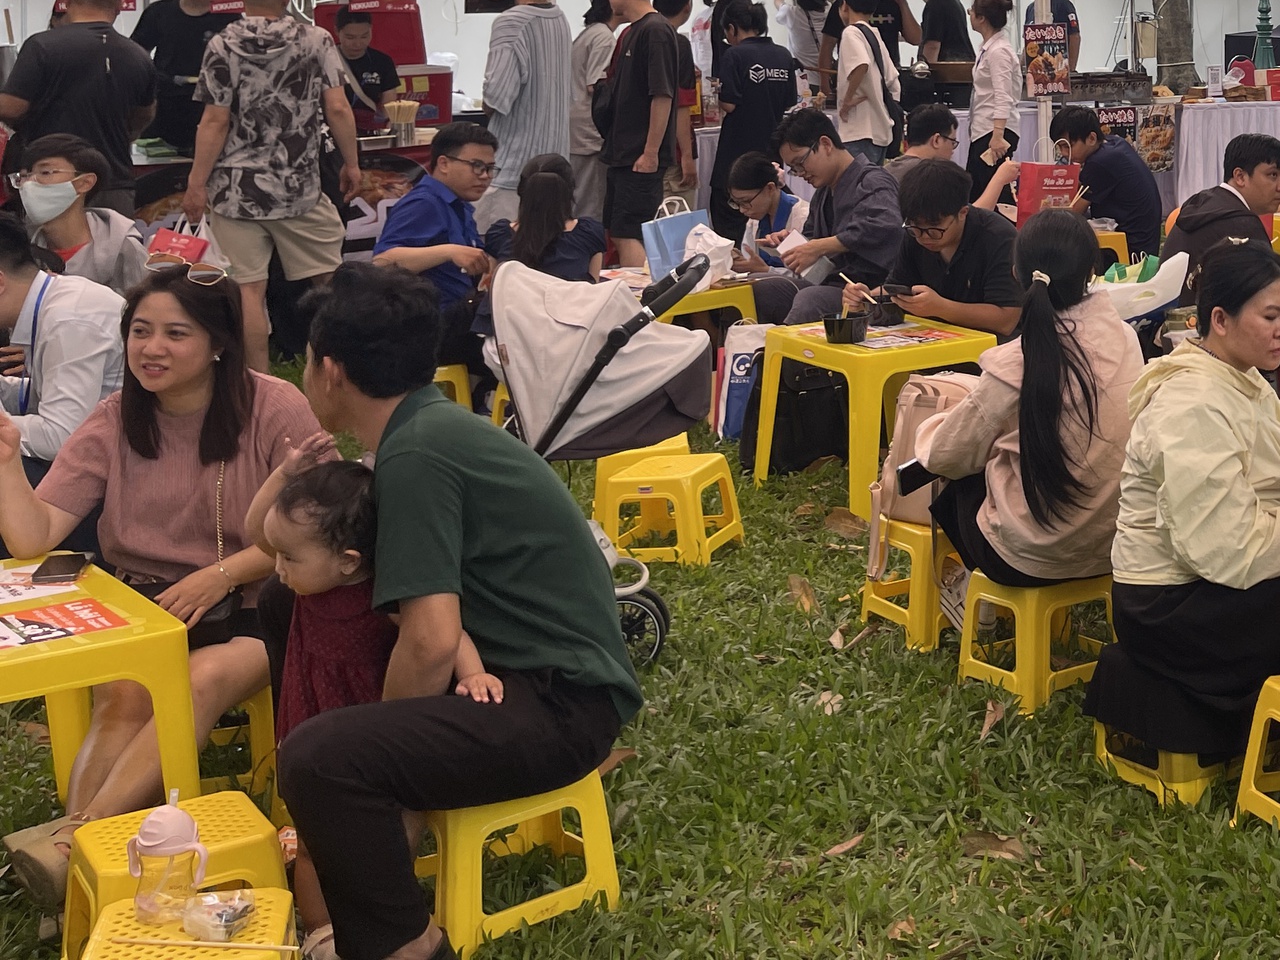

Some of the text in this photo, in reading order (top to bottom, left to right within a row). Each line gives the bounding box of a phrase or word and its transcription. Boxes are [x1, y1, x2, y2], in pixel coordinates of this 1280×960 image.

[1025, 26, 1064, 40] たい焼き
[1099, 109, 1135, 124] たい焼き
